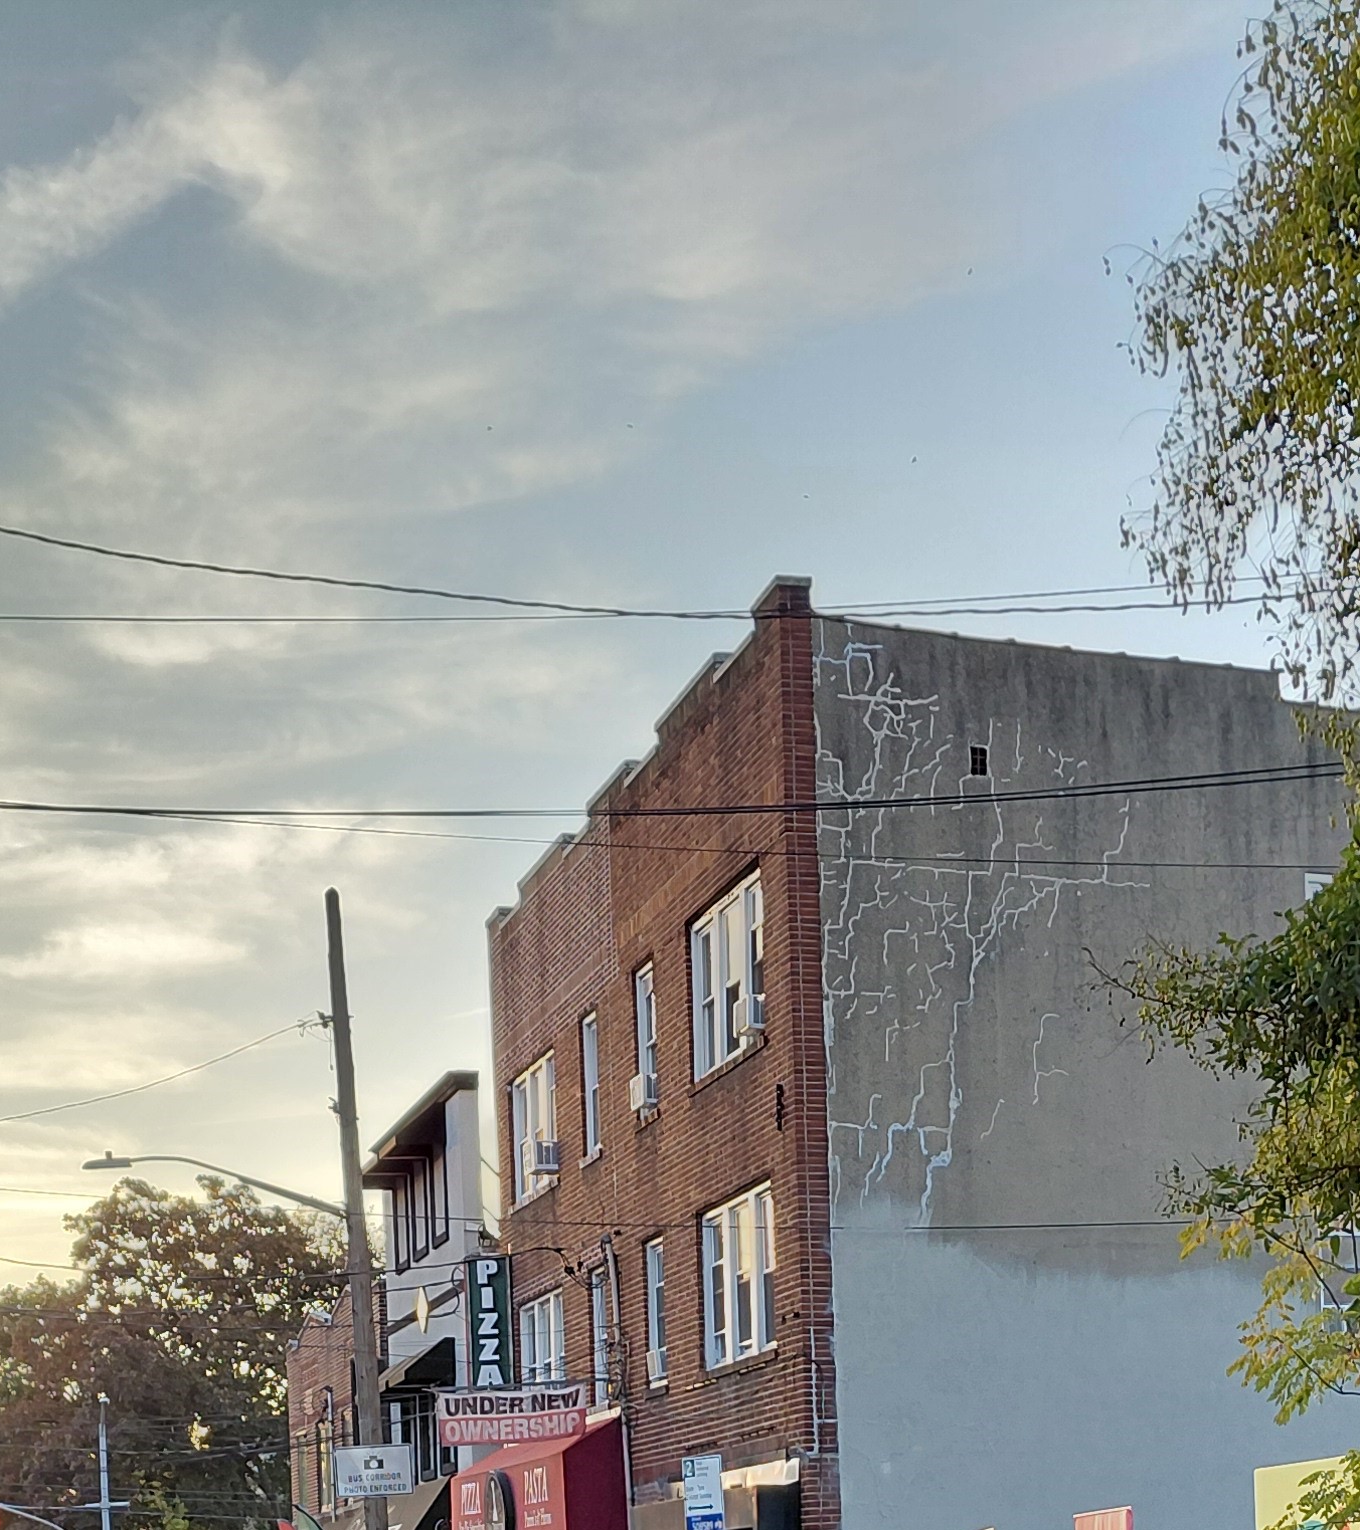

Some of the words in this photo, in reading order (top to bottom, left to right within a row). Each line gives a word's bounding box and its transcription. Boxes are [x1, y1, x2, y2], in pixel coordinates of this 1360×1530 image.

[476, 1260, 504, 1387] PIZZA
[445, 1396, 523, 1417] UNDER
[531, 1389, 581, 1411] NEW
[445, 1412, 581, 1442] OWNERSHIP
[344, 1485, 368, 1494] PHOTO
[369, 1483, 407, 1492] ENFORCED
[348, 1475, 363, 1483] BUS
[524, 1466, 549, 1505] PASTA
[461, 1482, 482, 1515] PIZZA
